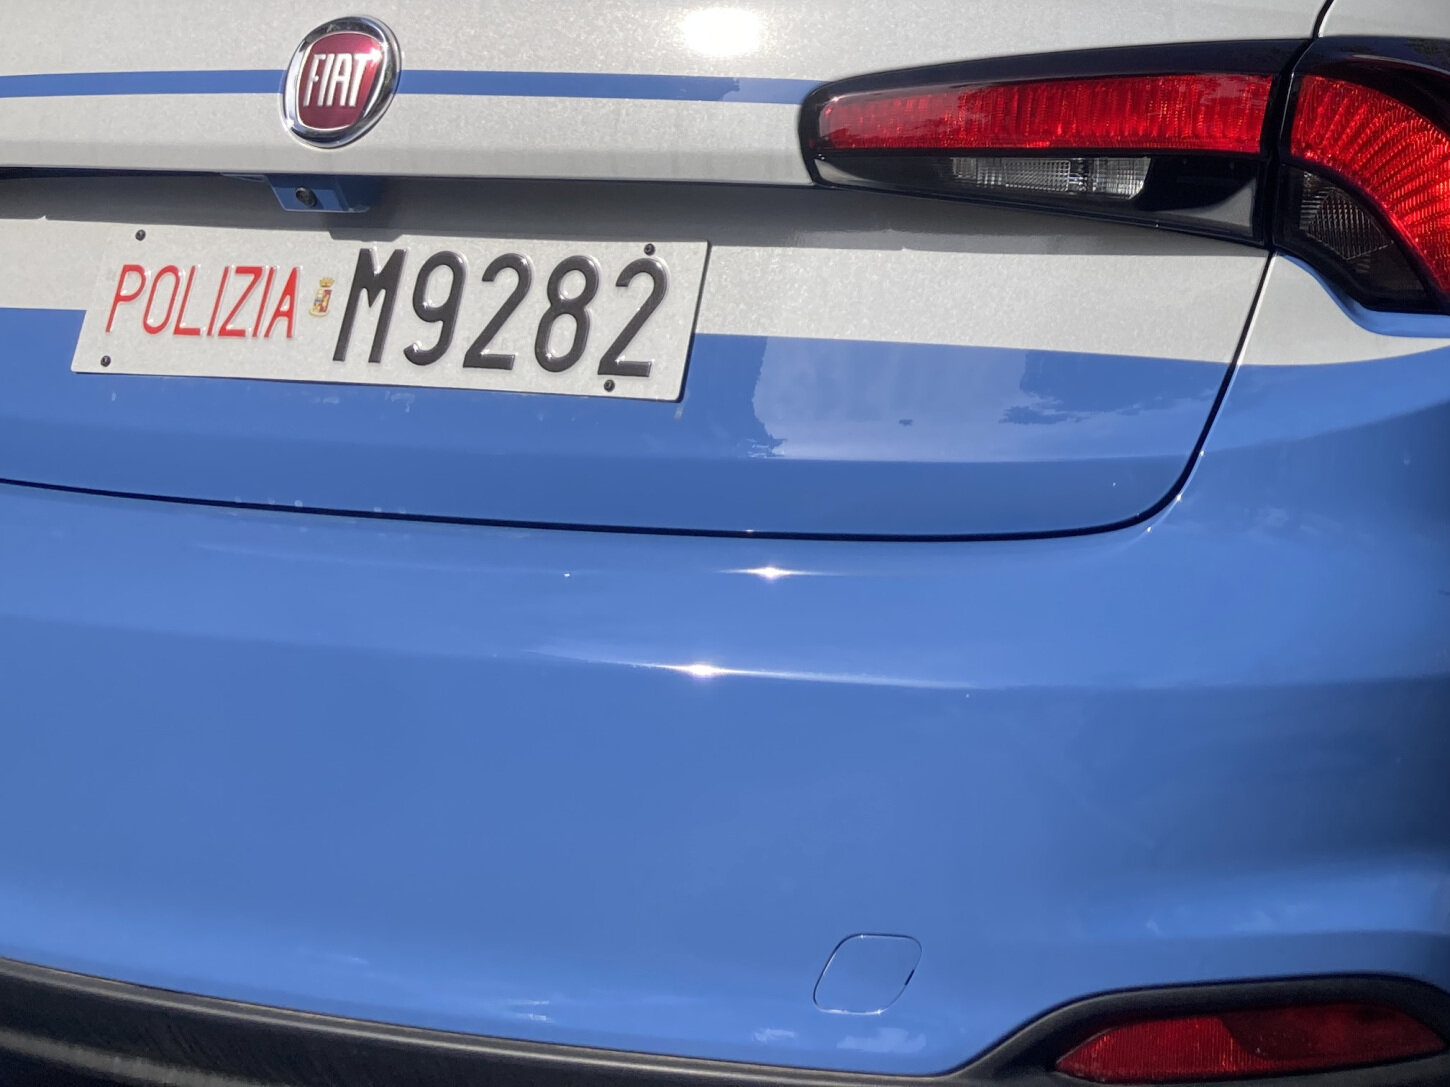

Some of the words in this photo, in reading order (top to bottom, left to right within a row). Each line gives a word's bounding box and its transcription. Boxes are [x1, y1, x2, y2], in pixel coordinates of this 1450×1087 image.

[303, 51, 382, 107] FIAT
[105, 264, 302, 339] POLIZIA
[332, 247, 666, 377] M9282
